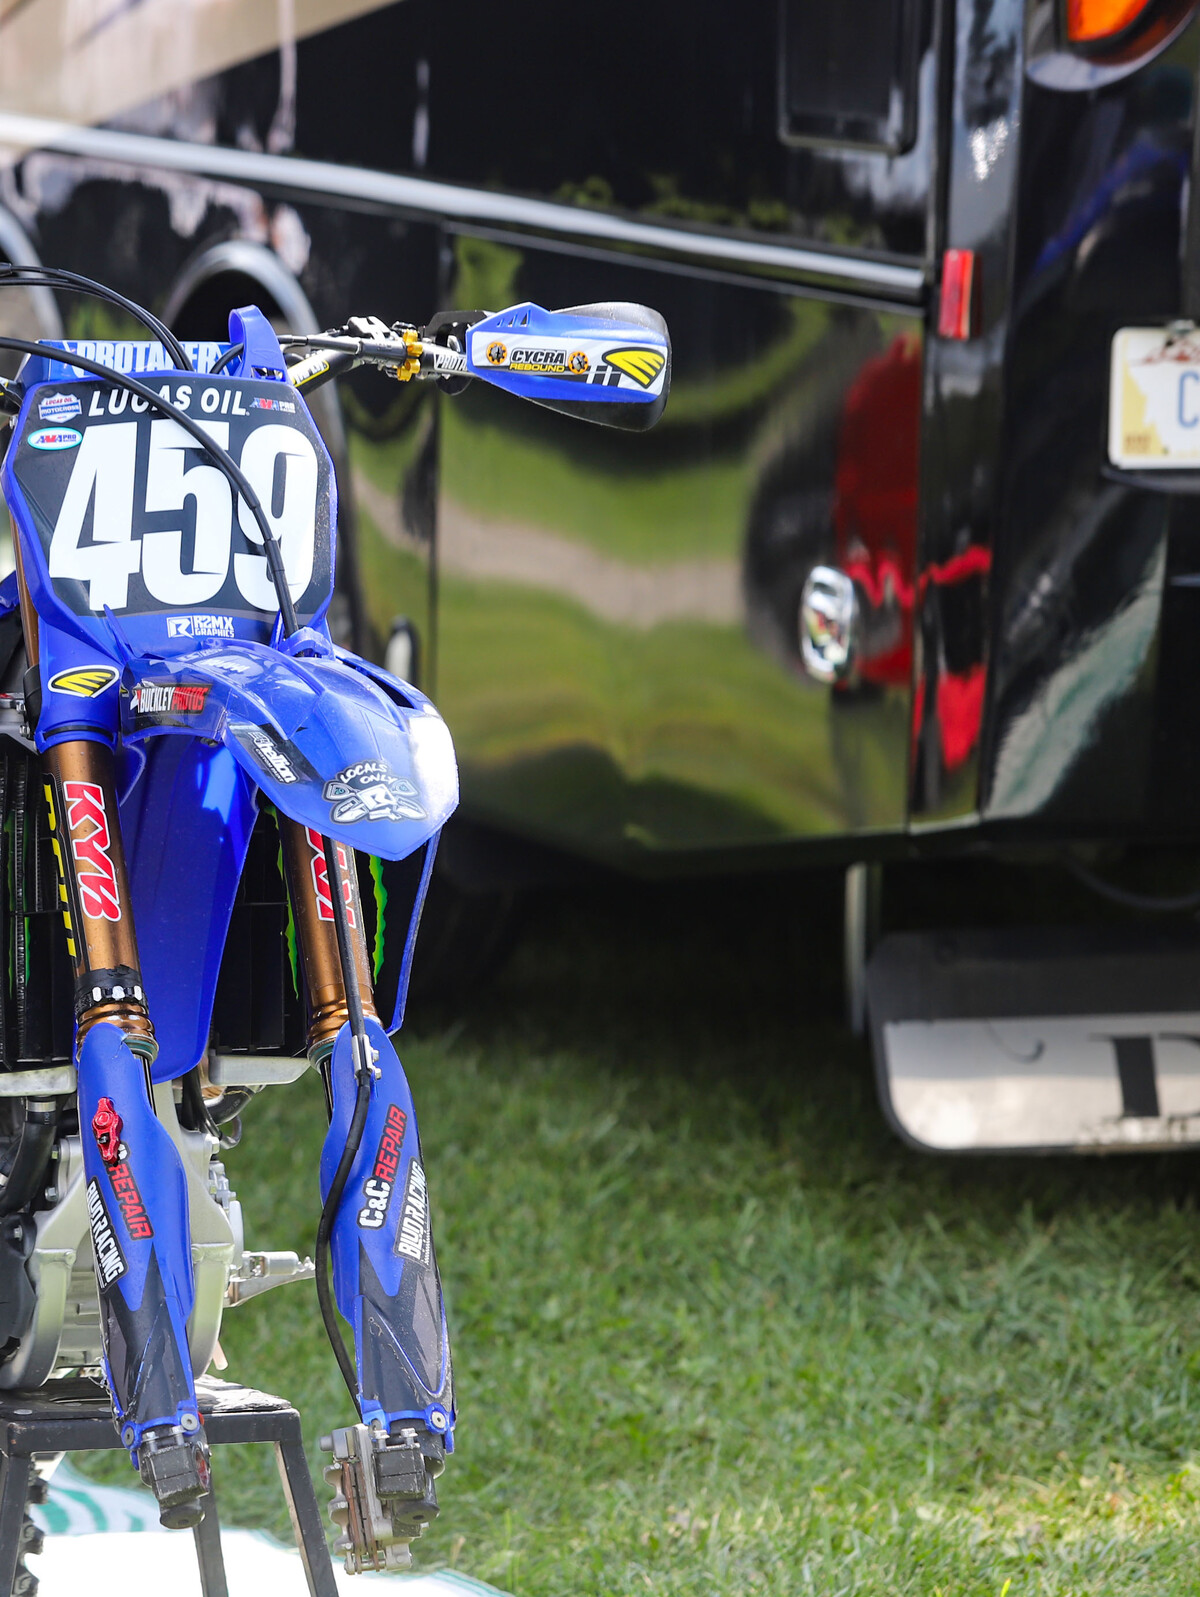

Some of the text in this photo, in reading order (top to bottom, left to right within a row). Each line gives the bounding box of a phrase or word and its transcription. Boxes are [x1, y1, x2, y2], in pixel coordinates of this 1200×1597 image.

[75, 342, 220, 375] PROTAER
[511, 350, 566, 364] CYCRA
[509, 363, 565, 373] REBOUND
[199, 387, 247, 416] OIL
[249, 397, 280, 411] AMA
[35, 434, 63, 444] AMA
[49, 419, 318, 612] 459
[193, 615, 234, 630] R2MX
[194, 628, 235, 638] GRAPHICS
[340, 762, 388, 784] LOCALS
[360, 773, 398, 784] ONLY
[63, 781, 122, 922] KYB
[375, 1106, 407, 1182] REPAIR
[109, 1163, 152, 1238] REPAIR
